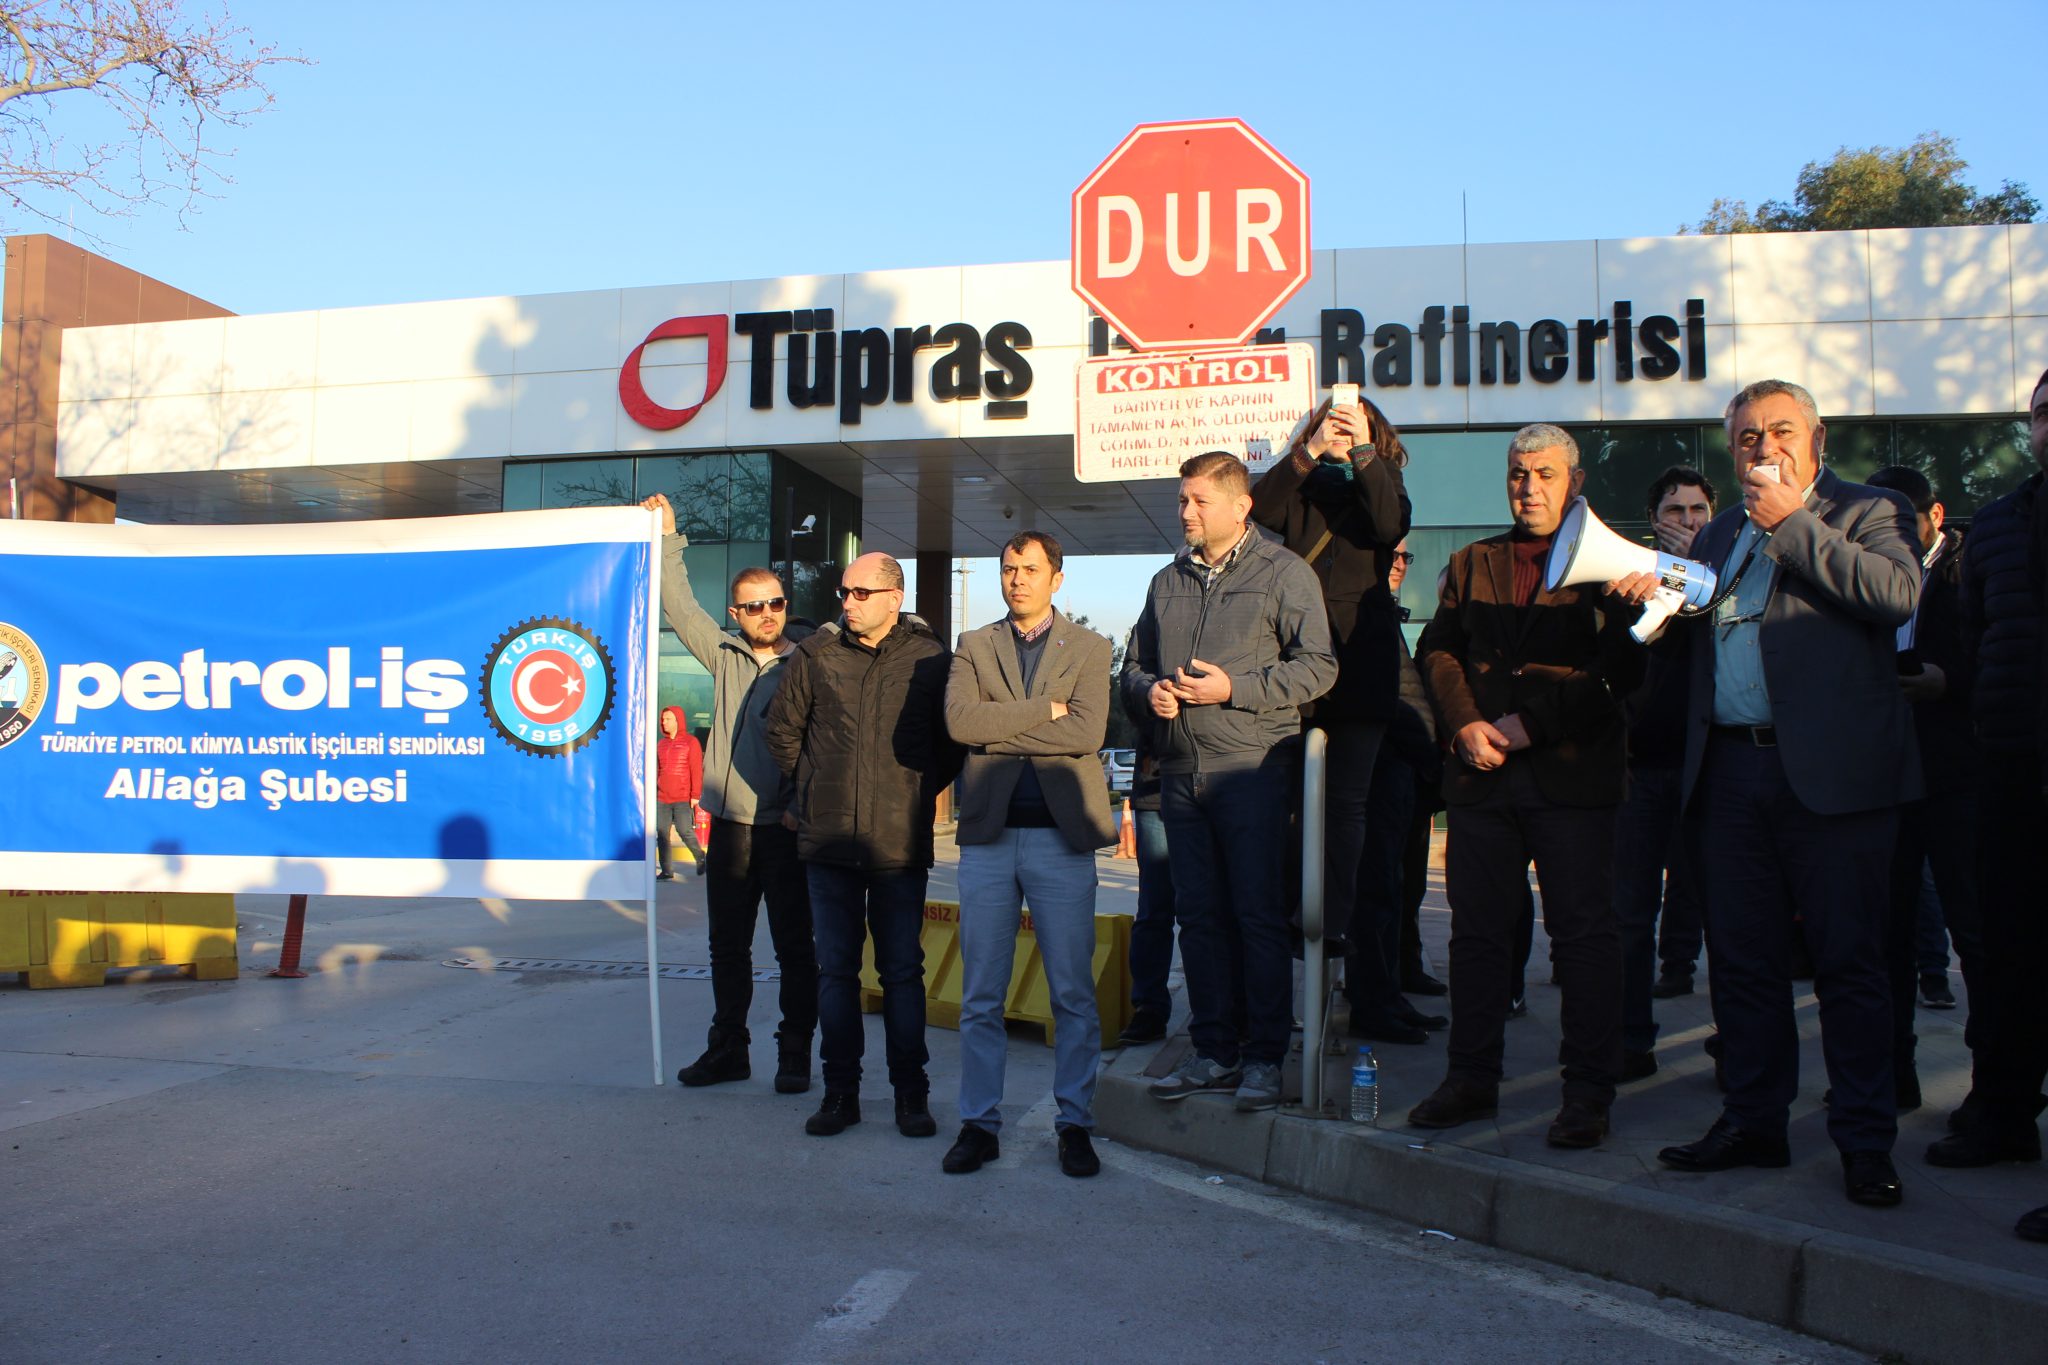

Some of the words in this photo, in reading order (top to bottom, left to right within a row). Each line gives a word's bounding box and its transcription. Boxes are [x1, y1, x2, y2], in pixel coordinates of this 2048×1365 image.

[1097, 187, 1288, 279] DUR
[1320, 298, 1707, 388] Rafinerisi
[734, 307, 1034, 425] Tüpraş
[1105, 359, 1284, 391] KONTROL
[499, 631, 597, 669] TÜRK-İŞ
[54, 646, 470, 725] petrol-iş
[40, 731, 118, 754] TÜRKİYE
[121, 736, 187, 755] PETROL
[191, 732, 245, 755] KİMYA
[248, 732, 307, 755] LASTİK
[312, 732, 384, 760] İŞÇİLERİ
[389, 732, 485, 755] SENDİKASI
[518, 722, 581, 743] 1952
[104, 766, 246, 809] Aliağa
[260, 768, 408, 810] Şubesi
